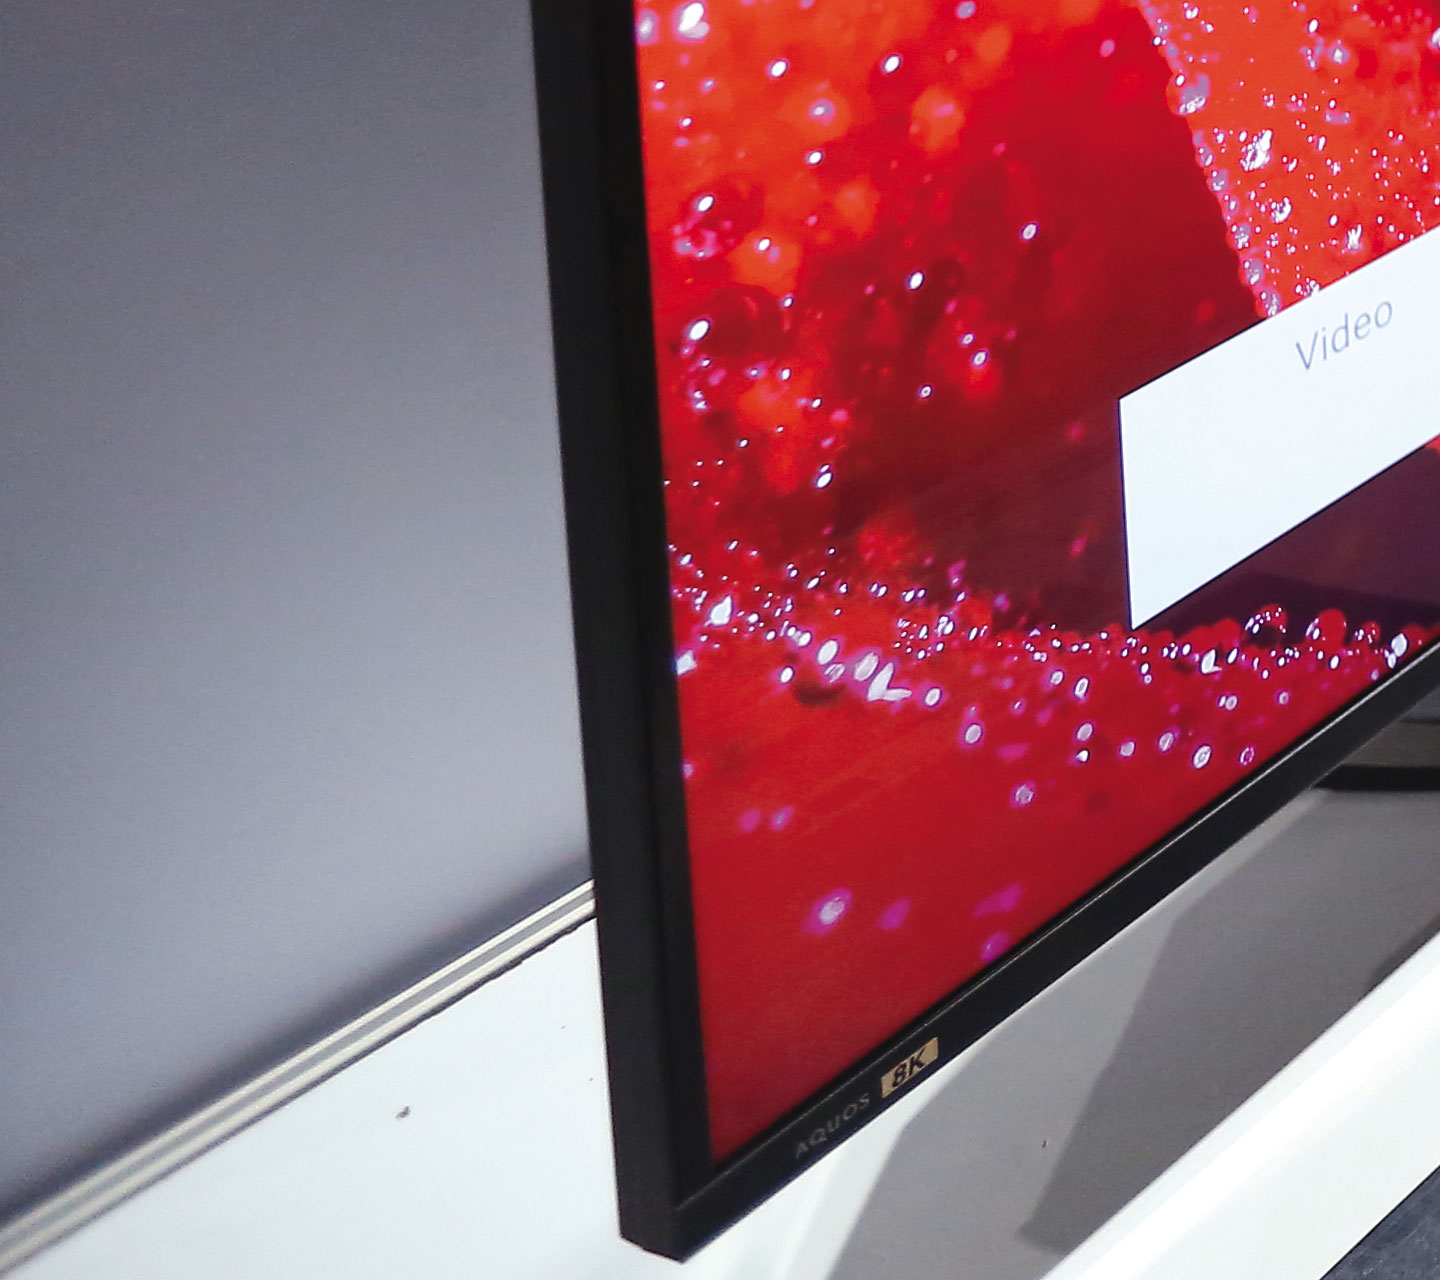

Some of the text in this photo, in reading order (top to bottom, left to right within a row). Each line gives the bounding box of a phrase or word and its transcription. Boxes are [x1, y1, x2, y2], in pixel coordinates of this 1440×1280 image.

[1295, 299, 1394, 372] Video
[796, 1047, 926, 1158] AQUOS 8K
